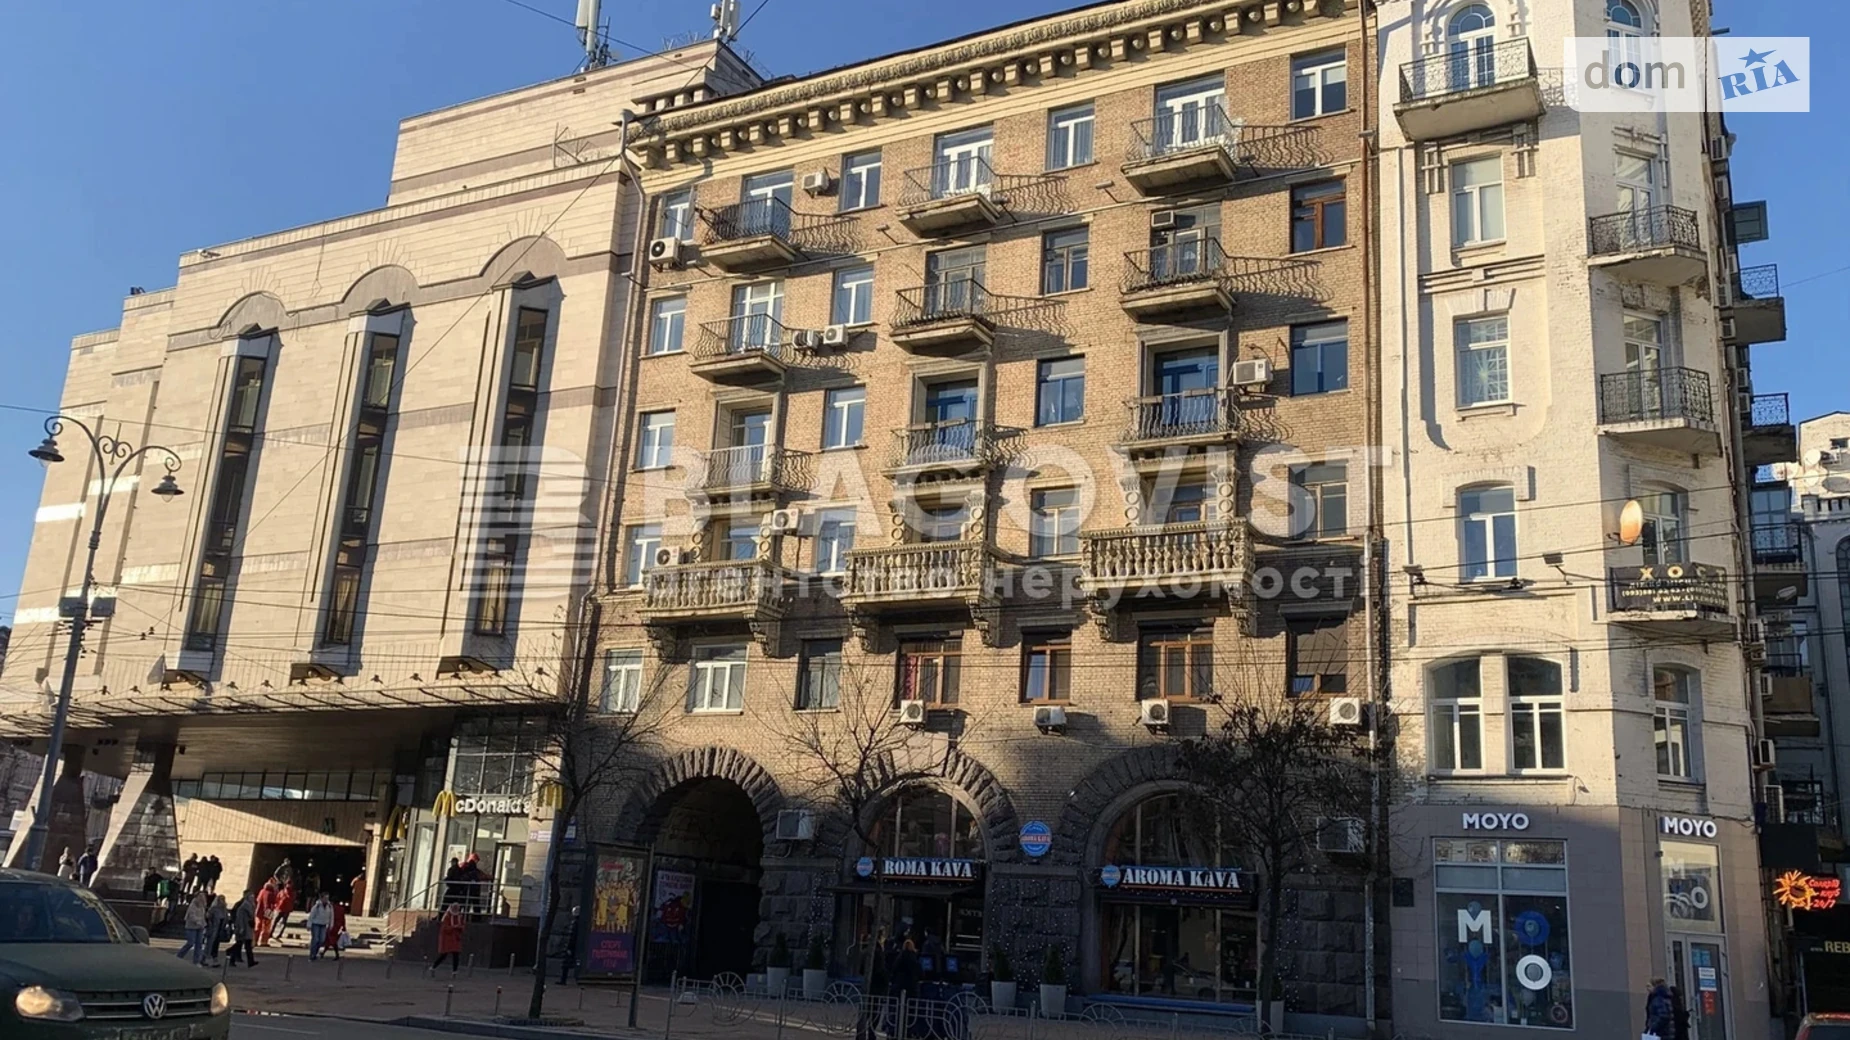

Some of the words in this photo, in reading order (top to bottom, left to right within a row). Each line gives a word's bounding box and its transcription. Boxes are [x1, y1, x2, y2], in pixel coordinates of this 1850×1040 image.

[1462, 812, 1529, 830] MOYO
[1664, 816, 1717, 838] MOYO
[873, 859, 927, 876] ROMA
[930, 861, 973, 877] KAVA
[1122, 868, 1185, 886] AROMA
[1190, 870, 1241, 888] KAVA
